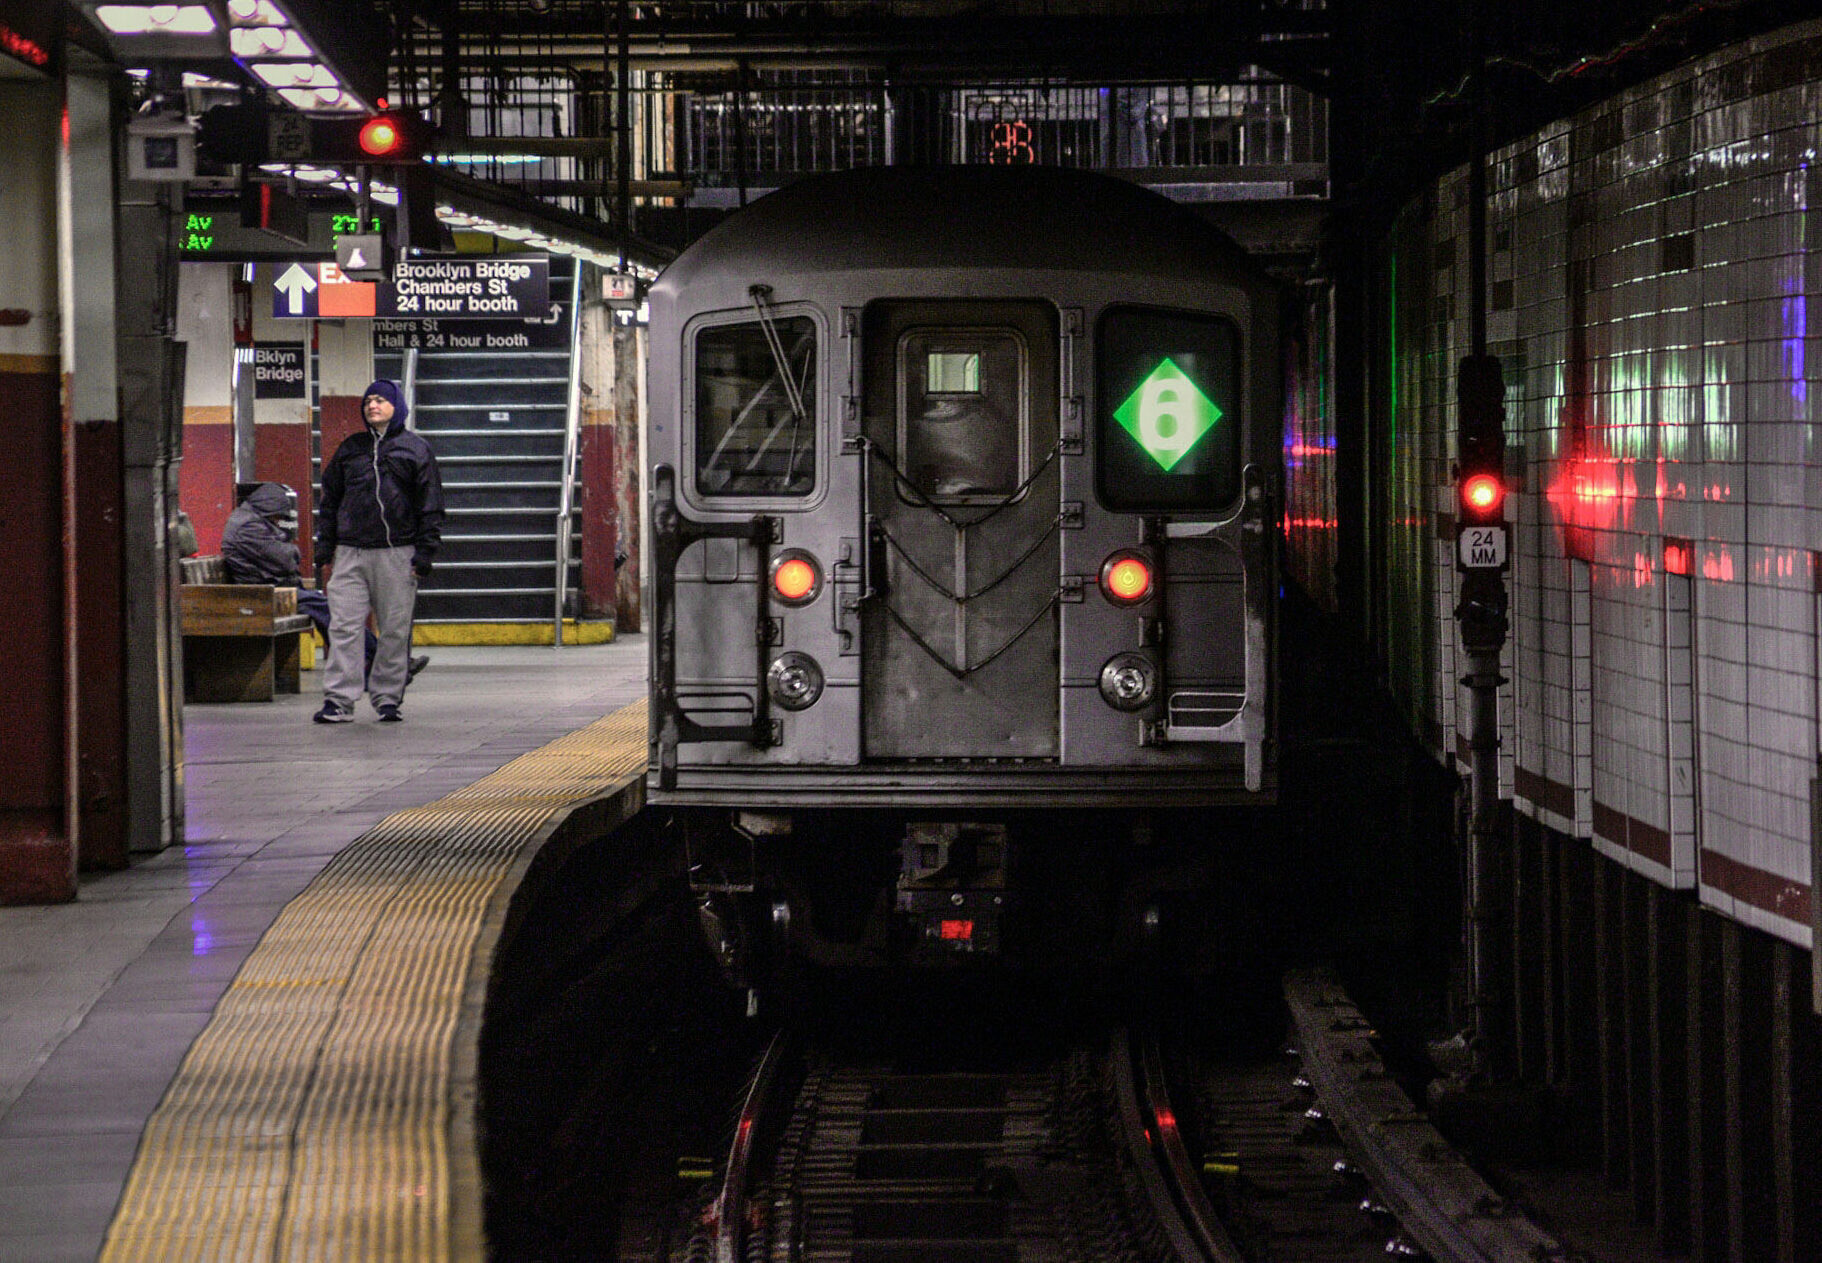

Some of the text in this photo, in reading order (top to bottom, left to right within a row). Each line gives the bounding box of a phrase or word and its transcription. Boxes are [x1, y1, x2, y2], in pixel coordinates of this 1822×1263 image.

[185, 213, 213, 230] Av
[186, 234, 213, 251] Av
[396, 262, 531, 280] Brooklyn Bridge
[396, 279, 508, 295] Chambers St
[397, 296, 518, 312] 24 hour booth
[374, 318, 438, 332] mbers St
[378, 334, 528, 348] Hall & 24 hour booth
[255, 350, 296, 366] Bklyn
[255, 366, 304, 382] Bridge
[1139, 378, 1195, 451] 6
[1472, 530, 1494, 547] 24
[1472, 548, 1496, 565] MM
